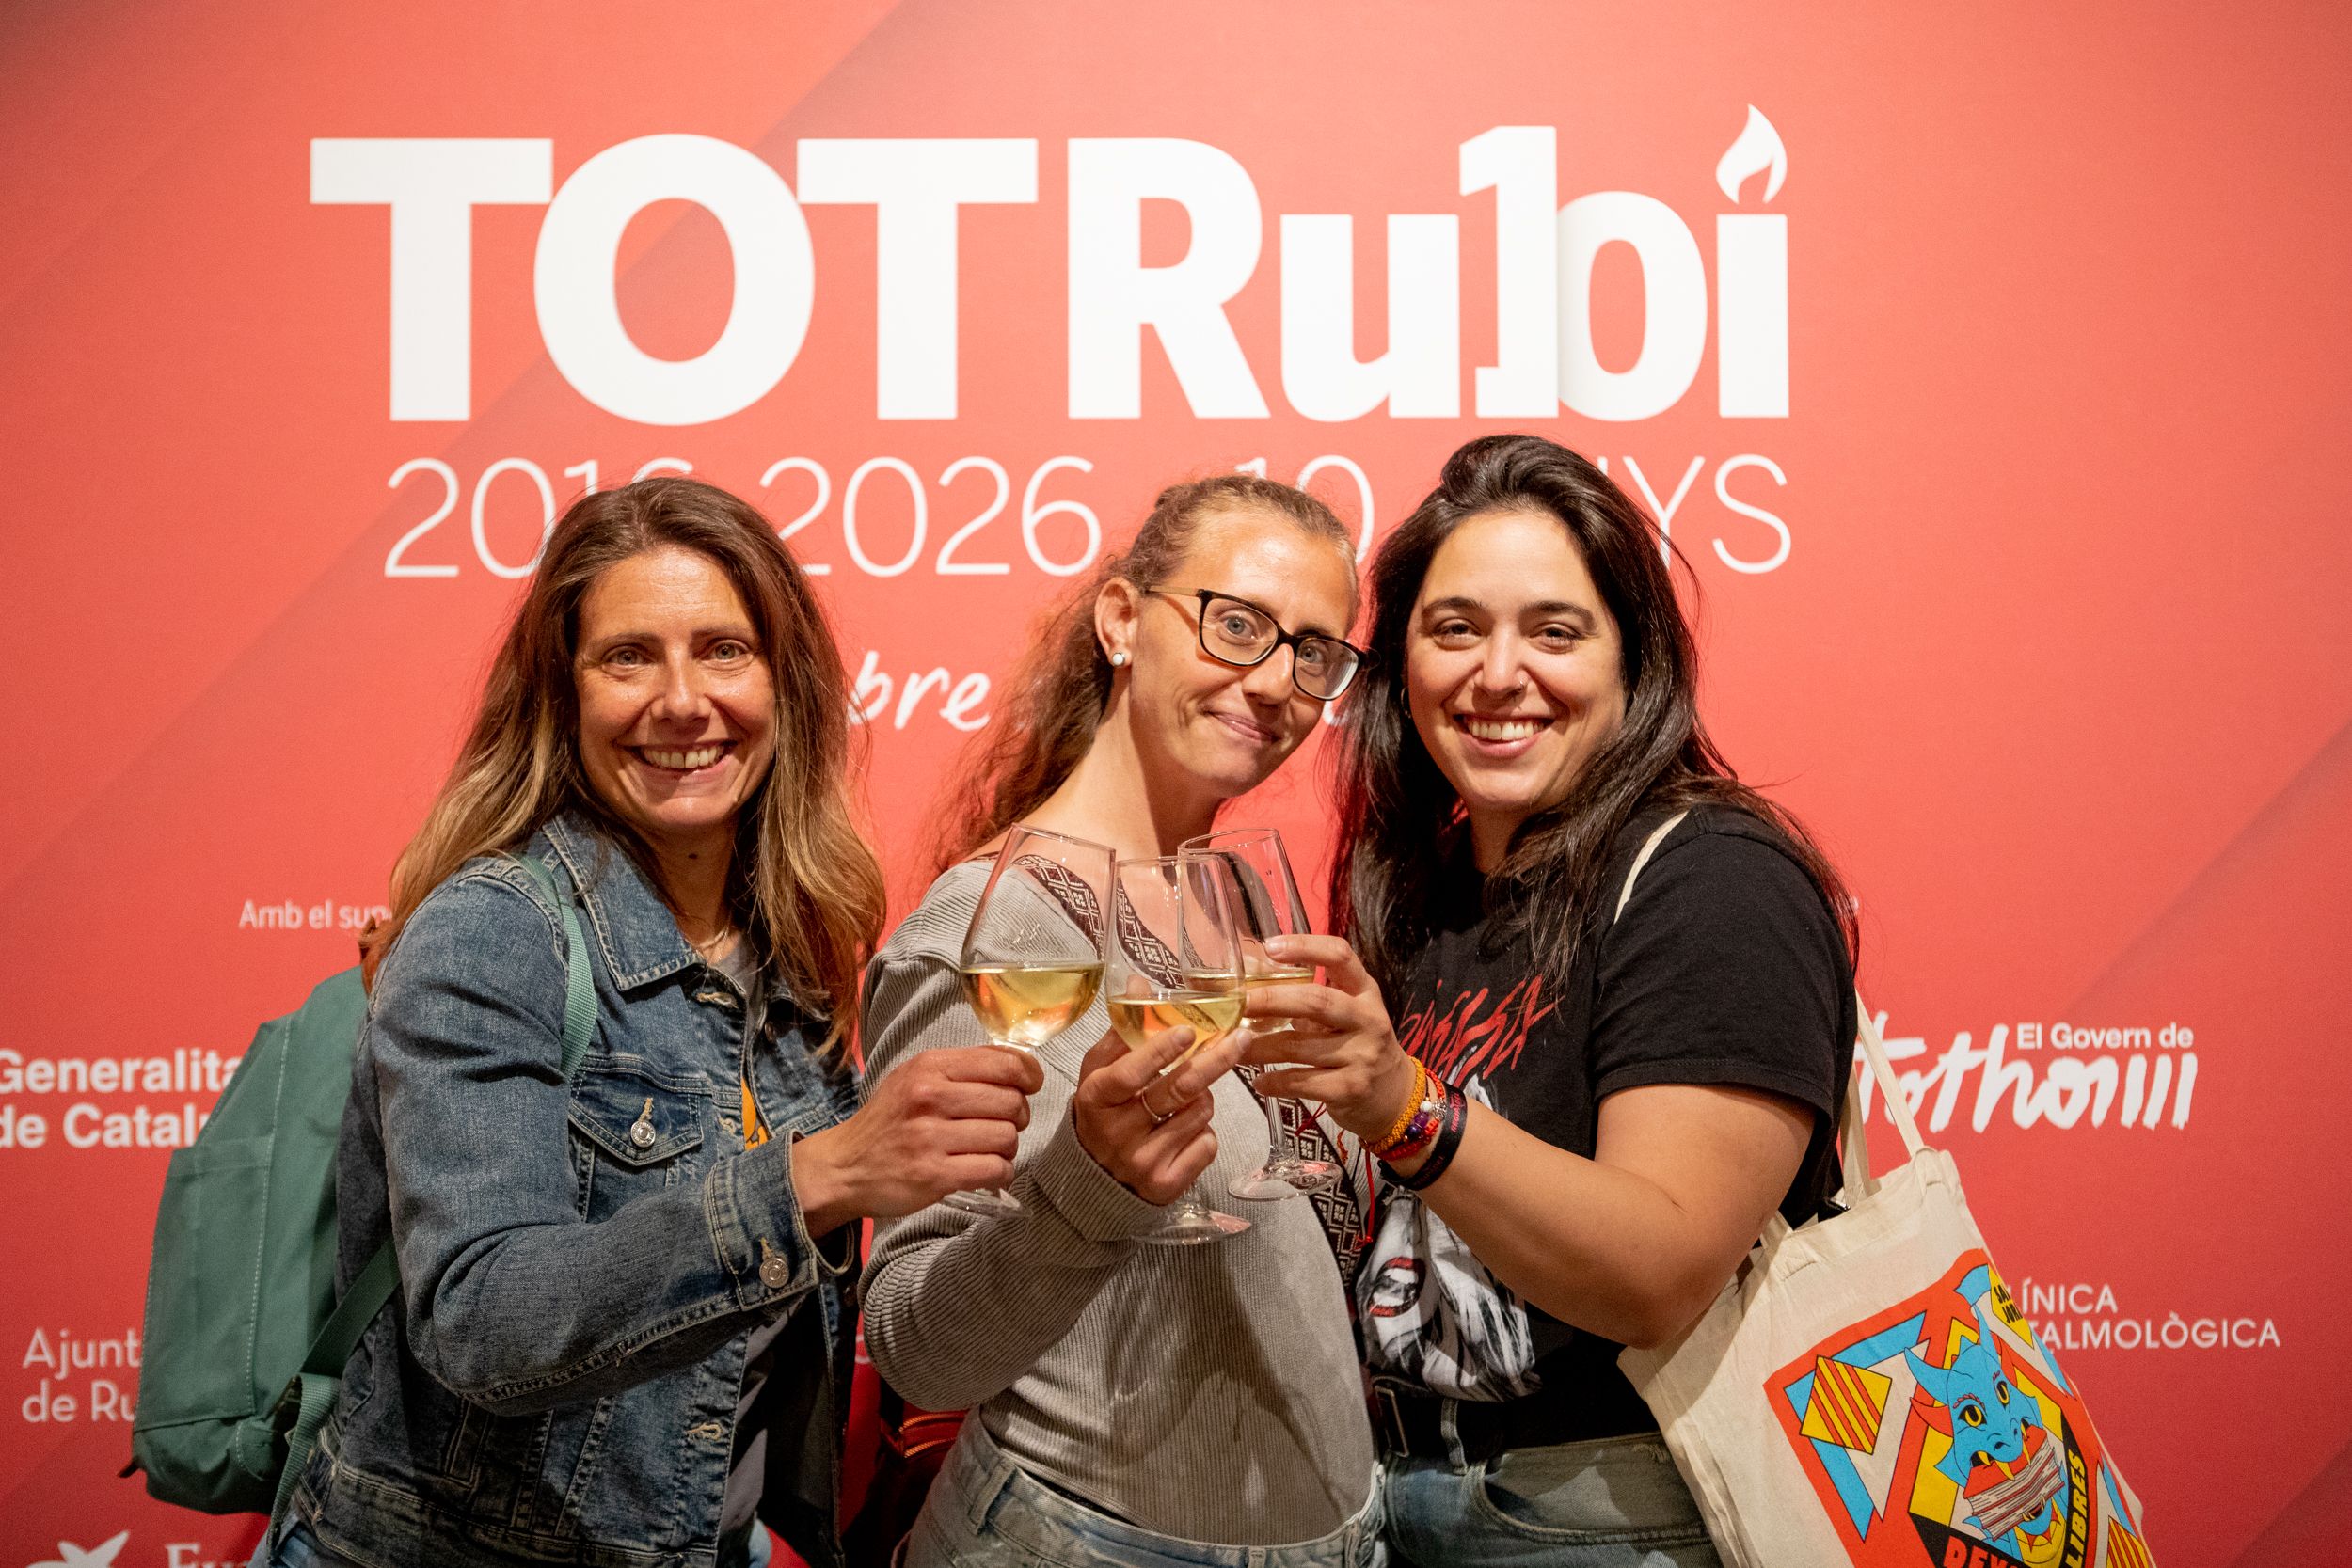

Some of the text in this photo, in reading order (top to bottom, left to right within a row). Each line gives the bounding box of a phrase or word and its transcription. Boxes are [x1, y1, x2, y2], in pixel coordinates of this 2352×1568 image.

[384, 453, 1792, 578] 20 2026 0 YS
[238, 898, 304, 929] Amb
[309, 899, 333, 929] el
[2016, 1022, 2194, 1050] El Govern de
[63, 1101, 211, 1148] Catal
[2007, 1275, 2119, 1315] ÍNICA
[22, 1378, 76, 1423] de
